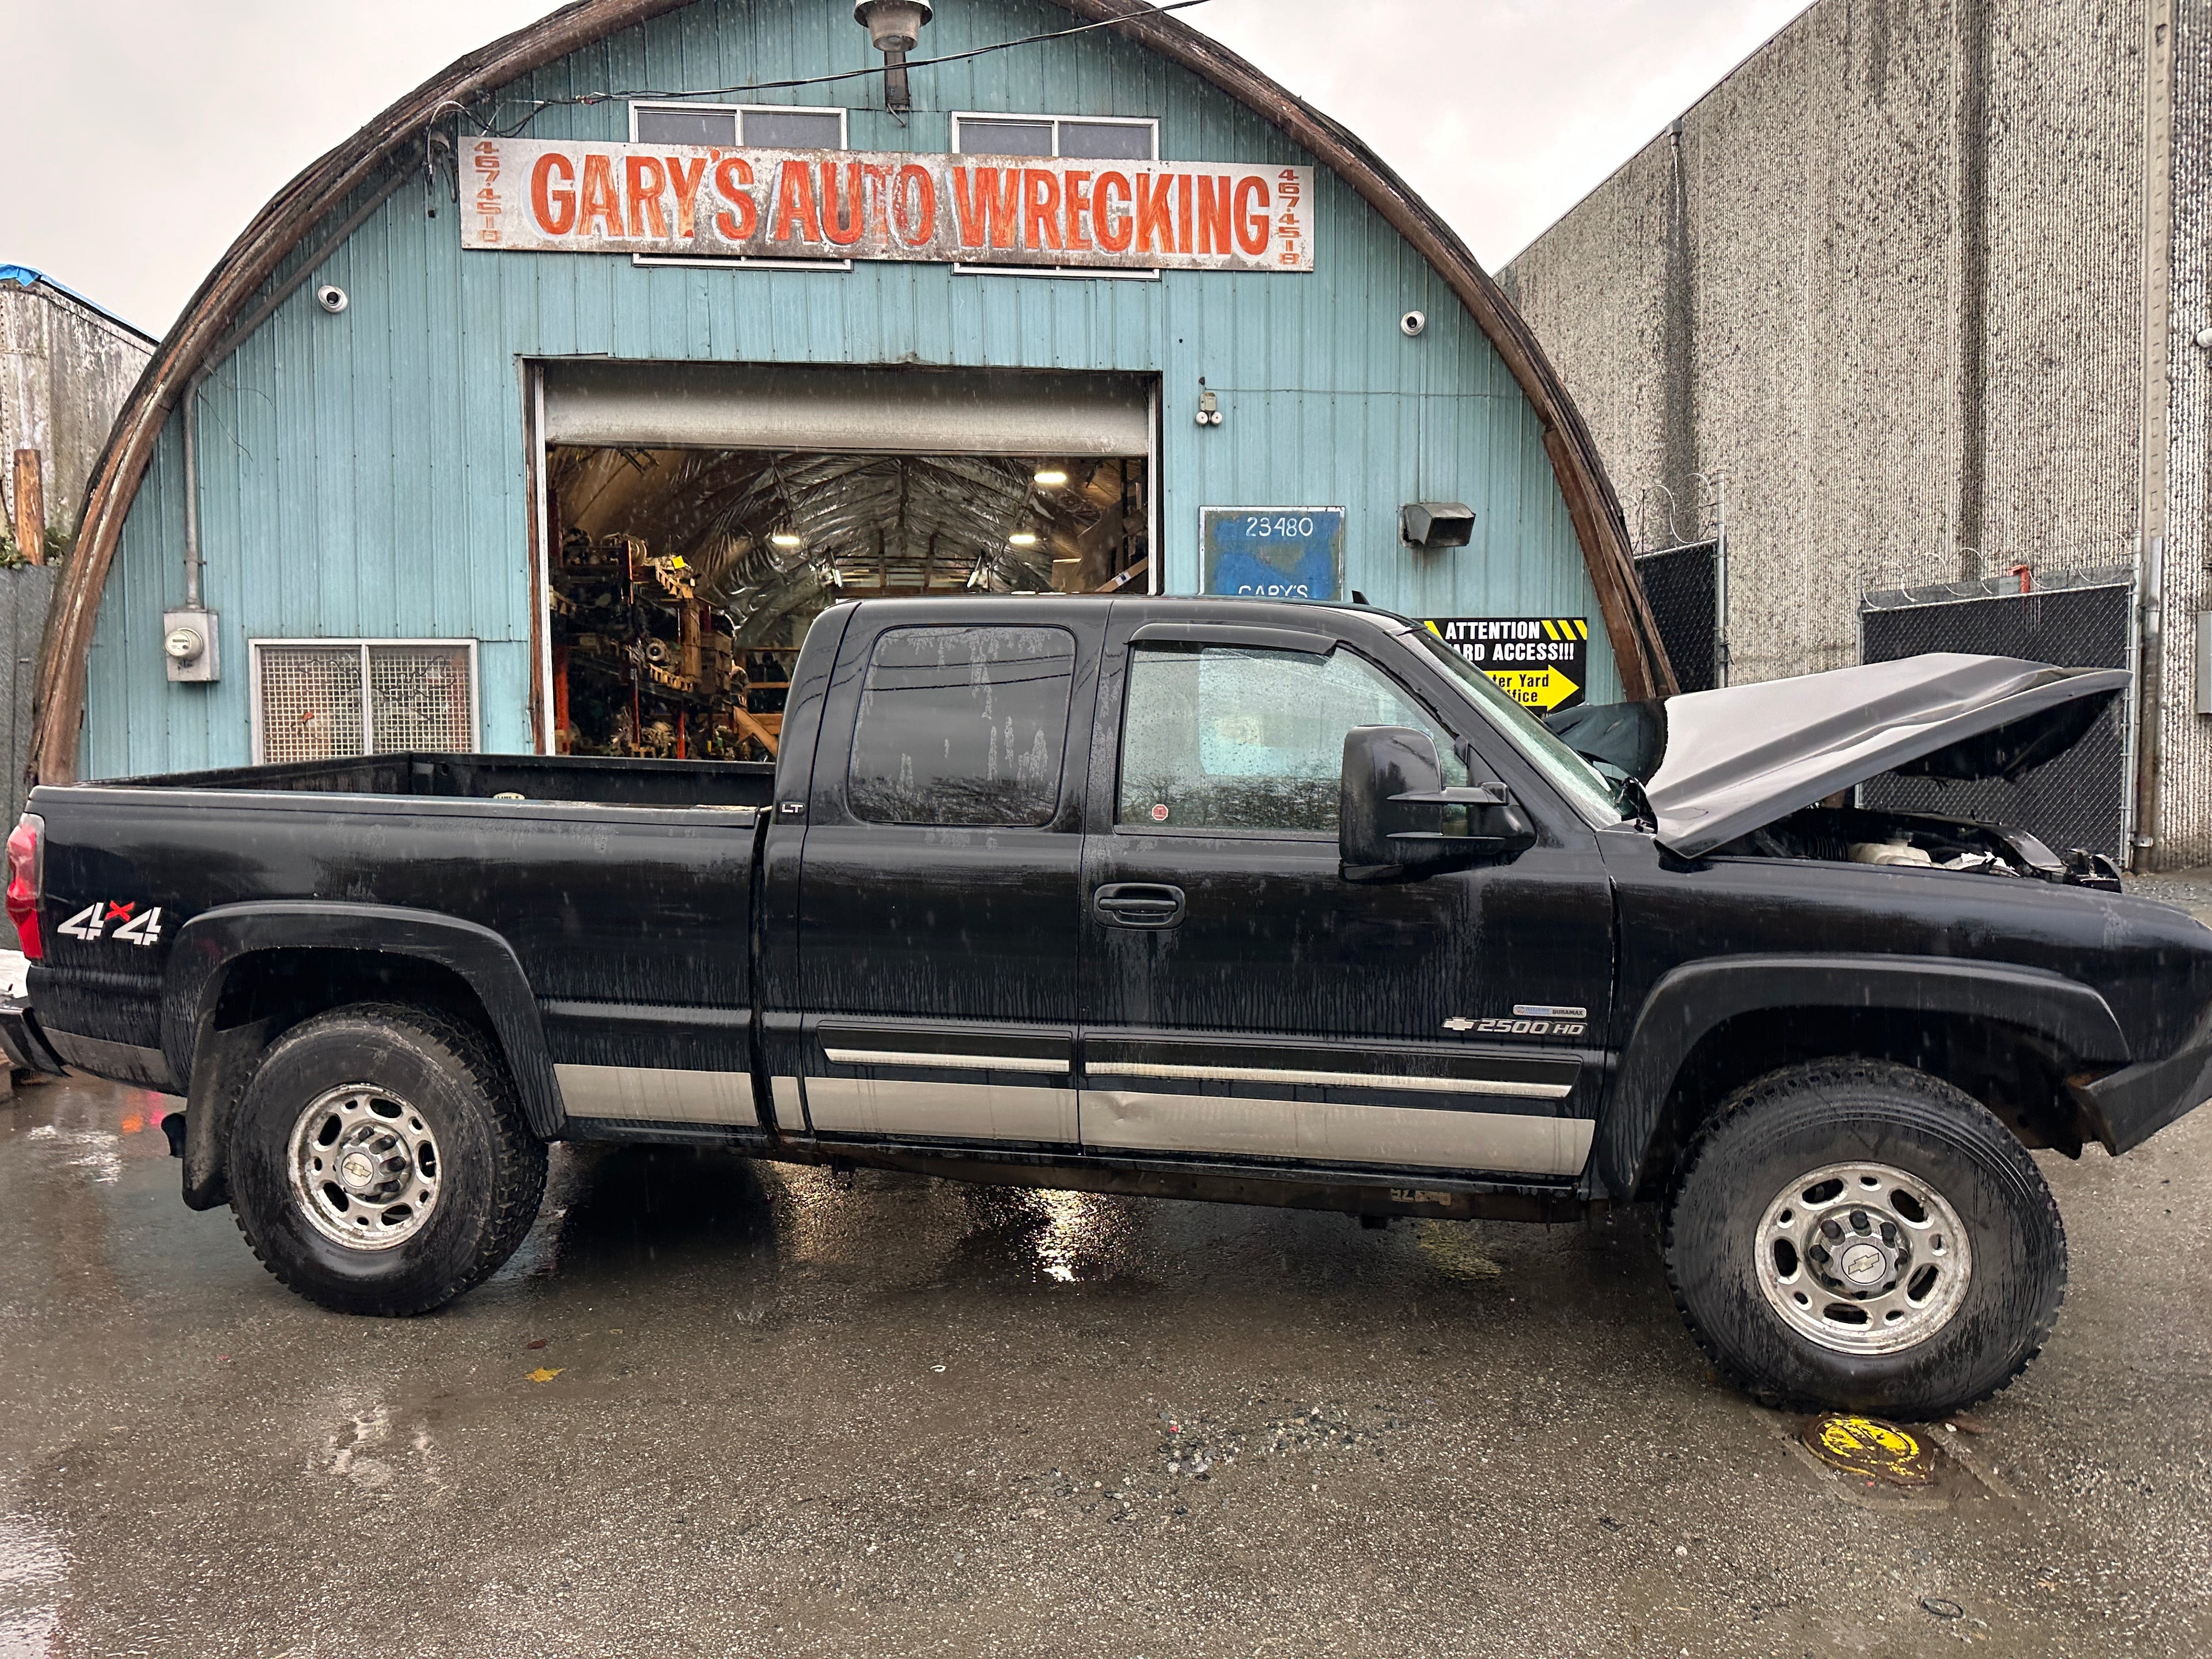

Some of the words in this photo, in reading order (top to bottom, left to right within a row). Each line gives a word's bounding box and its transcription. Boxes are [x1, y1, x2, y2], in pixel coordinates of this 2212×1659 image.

[530, 149, 757, 241] GARY'S
[775, 160, 935, 246] AUTO
[952, 166, 1270, 255] WRECKING
[1245, 516, 1313, 537] 23480
[1445, 621, 1540, 640] ATTENTION
[1449, 643, 1485, 661] RD
[1492, 642, 1574, 661] ACCESS!!!
[1518, 673, 1549, 687] Yard
[1506, 689, 1538, 702] fice
[782, 804, 804, 813] LT
[1477, 1019, 1550, 1035] 2500
[1552, 1023, 1585, 1035] HD
